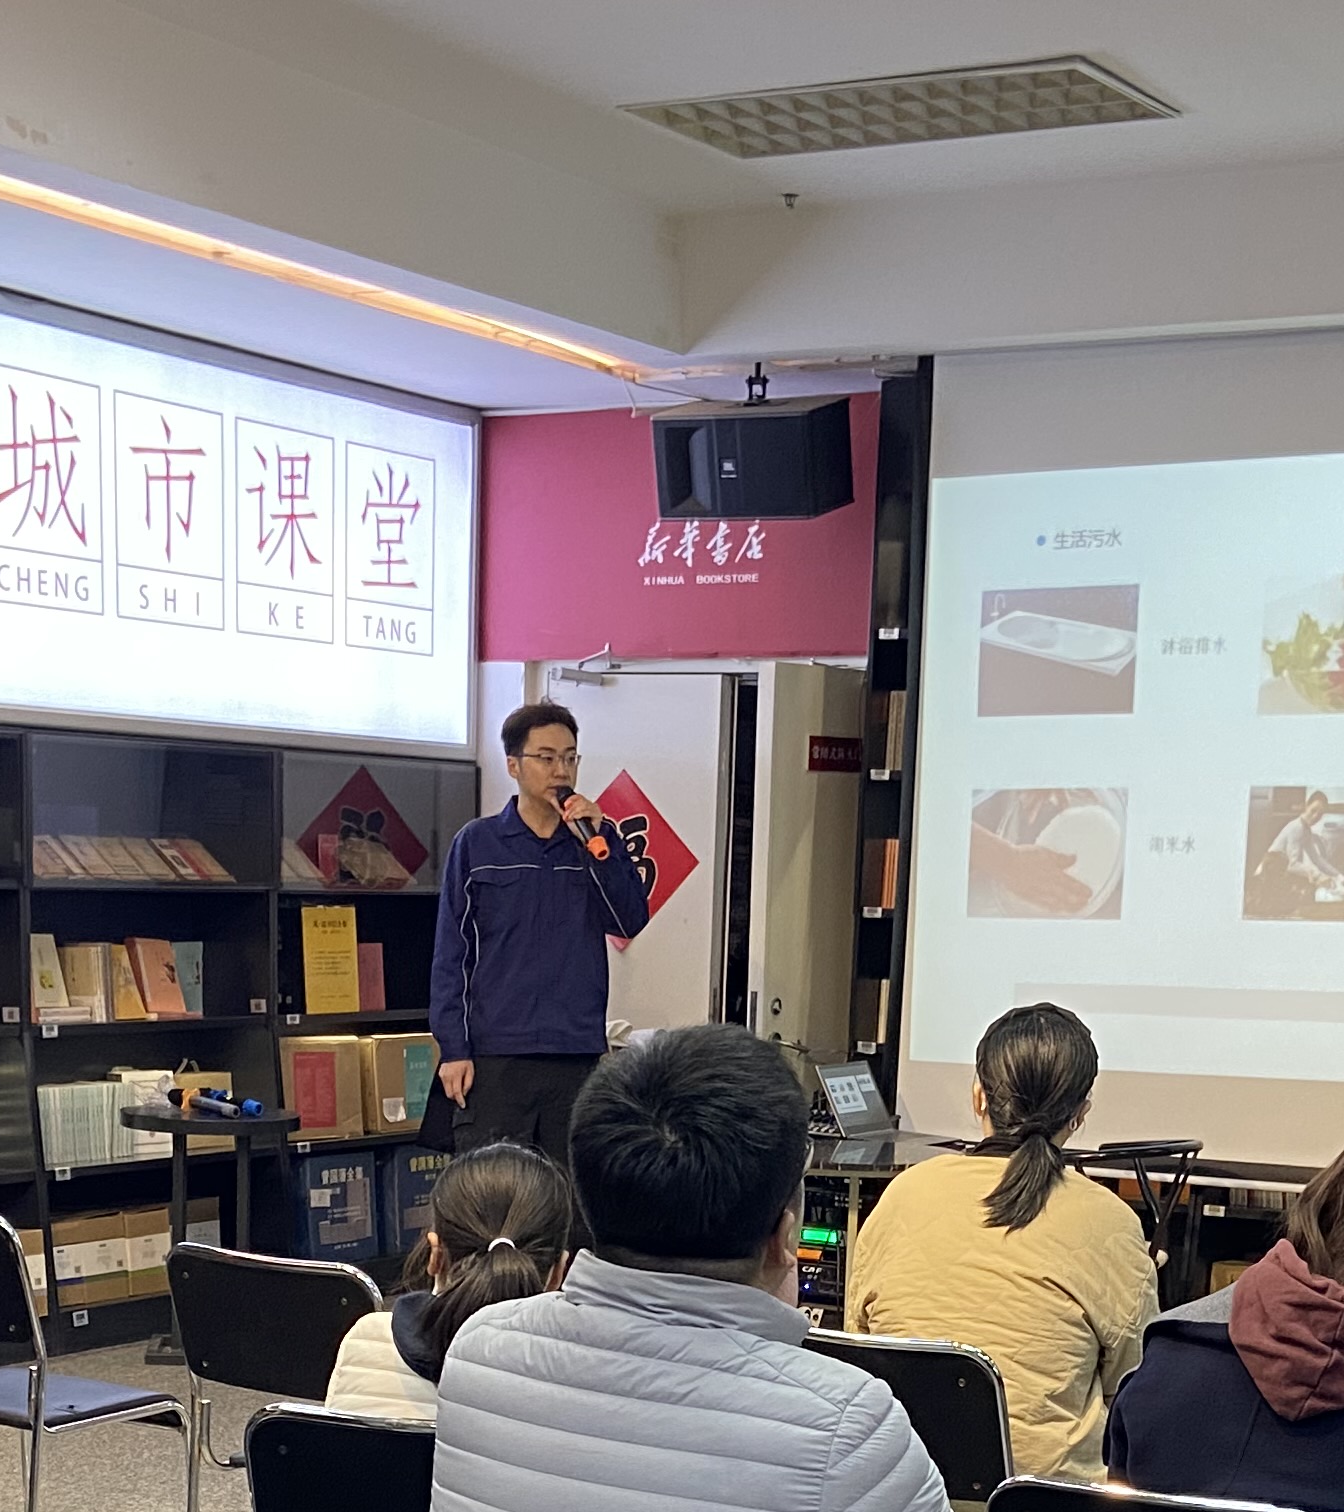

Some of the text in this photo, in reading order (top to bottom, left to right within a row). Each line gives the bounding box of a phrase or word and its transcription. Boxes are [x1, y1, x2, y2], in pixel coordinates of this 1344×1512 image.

[1052, 528, 1123, 551] 生活污水
[643, 573, 759, 587] XINHUA BOOKSTORE
[138, 584, 202, 617] SHI
[267, 601, 306, 630] KE
[362, 615, 418, 645] TANG
